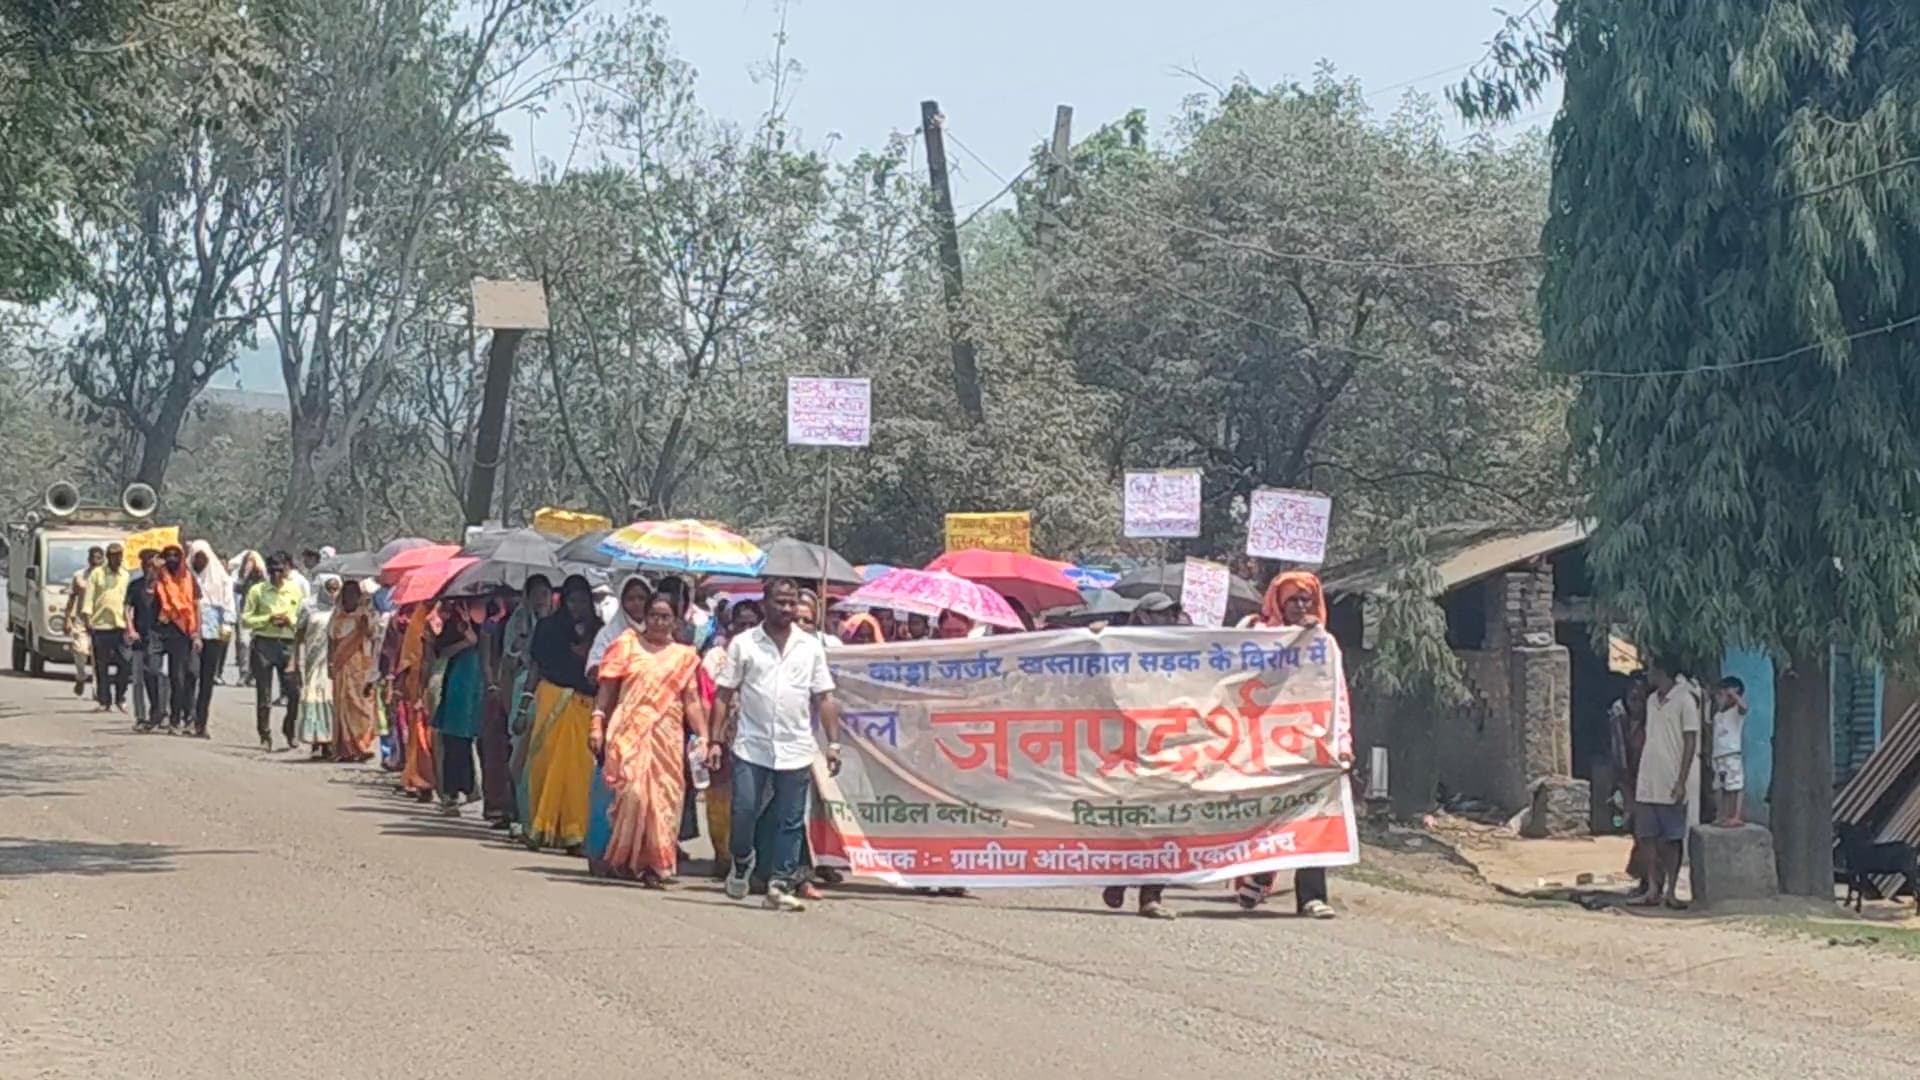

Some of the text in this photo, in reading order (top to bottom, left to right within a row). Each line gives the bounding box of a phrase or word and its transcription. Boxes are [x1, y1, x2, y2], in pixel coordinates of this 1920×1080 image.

[1018, 651, 1131, 678] खस्ताहाल
[1138, 650, 1202, 678] सड़क
[1208, 642, 1234, 673] के
[1240, 640, 1301, 673] विरोध
[1307, 636, 1328, 666] में
[856, 794, 931, 824] चांडिल
[1072, 798, 1157, 828] दिनांक:
[1167, 803, 1194, 824] 15
[950, 845, 1028, 871] ग्रामीण
[1033, 841, 1182, 872] आंदोलनकारी
[1187, 839, 1253, 871] एकता
